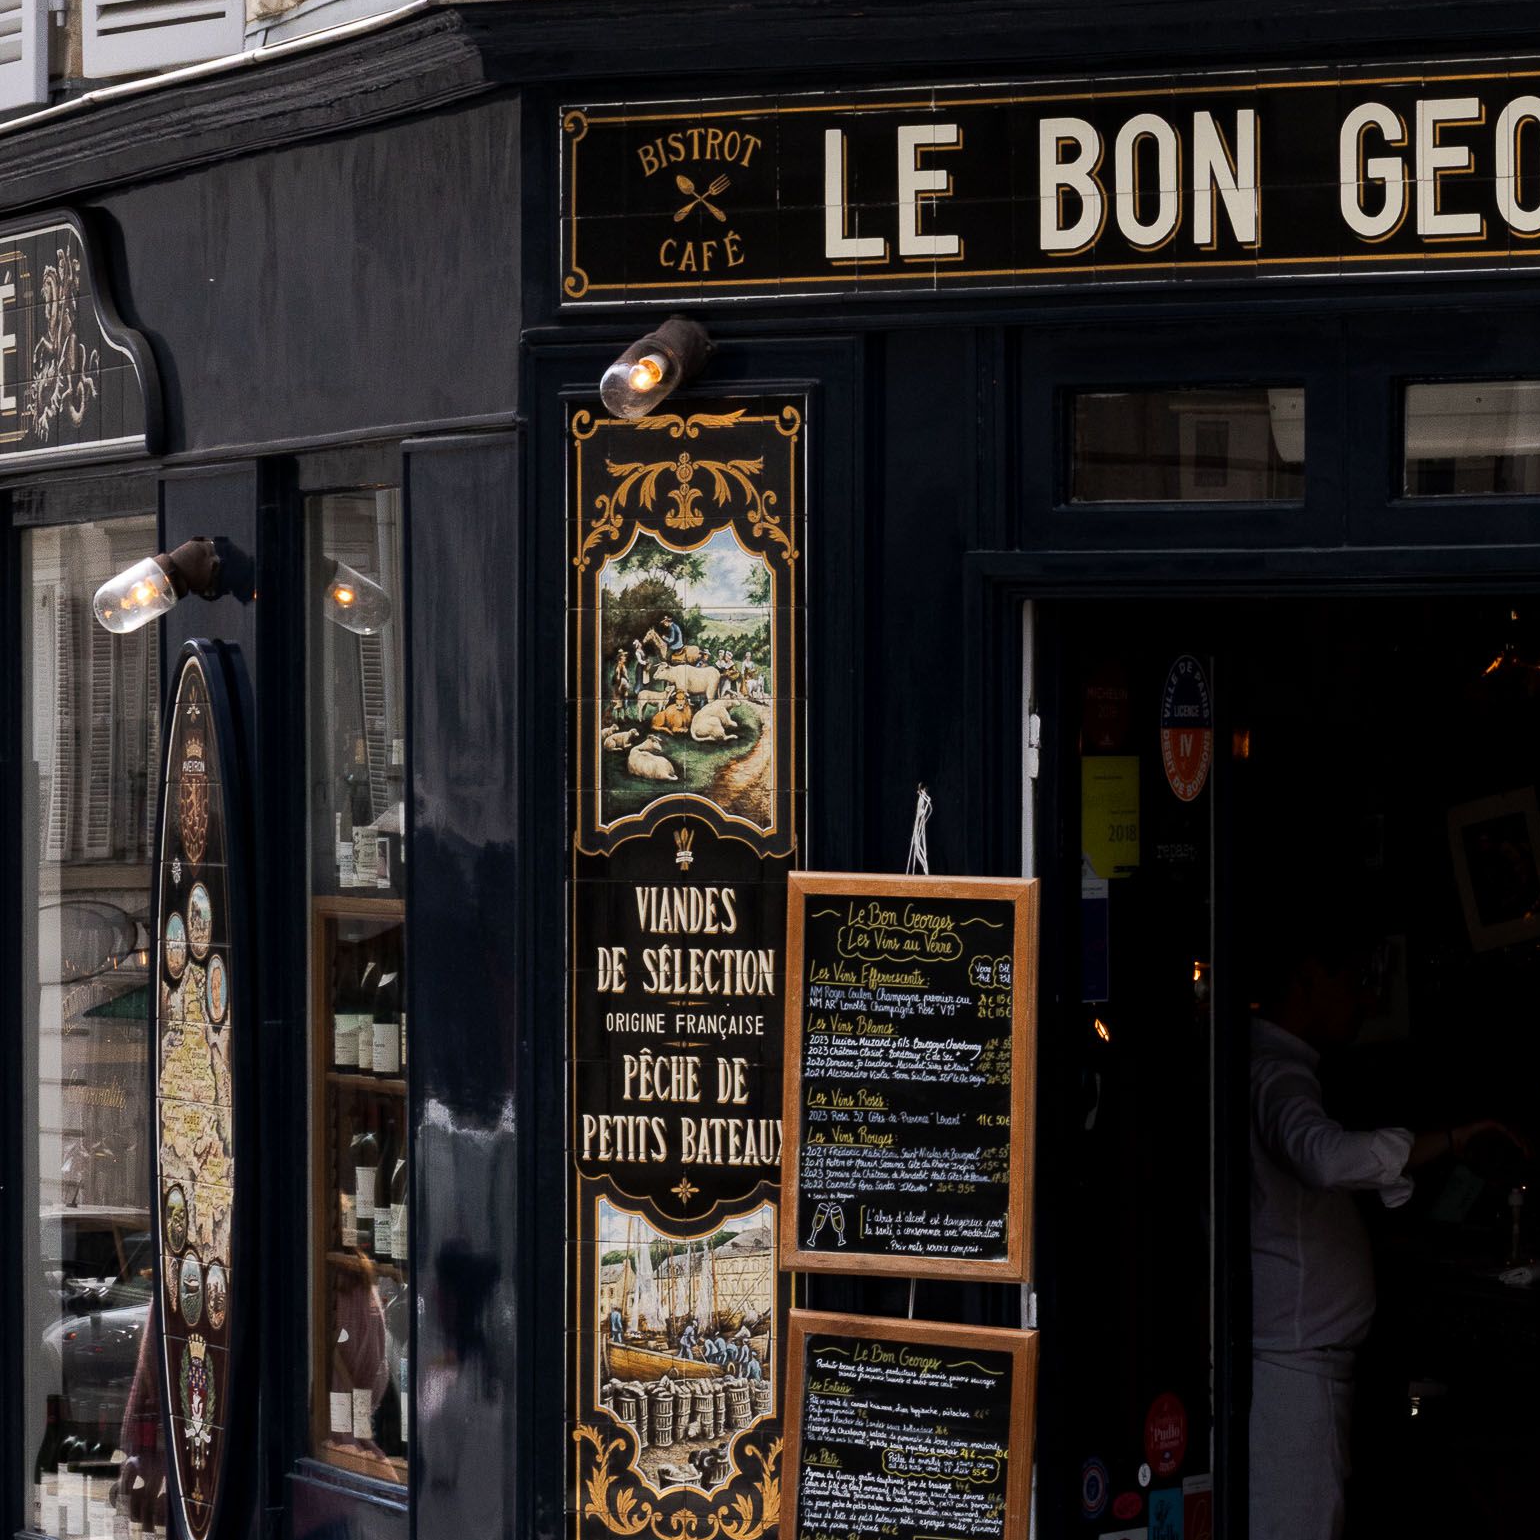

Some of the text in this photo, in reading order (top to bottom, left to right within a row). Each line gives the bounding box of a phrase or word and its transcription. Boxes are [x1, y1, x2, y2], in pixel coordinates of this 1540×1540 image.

[638, 128, 762, 178] BISTROT
[826, 124, 963, 263] LE
[1039, 110, 1262, 257] BON
[659, 230, 744, 272] CAFÉ
[1163, 661, 1210, 718] VILLE DE PARIS
[1179, 734, 1193, 758] IV
[1107, 824, 1137, 843] 2018
[635, 885, 737, 935] VIANDES
[848, 901, 956, 939] Le Bon Georges
[848, 928, 953, 953] Les Vins au Verre
[597, 944, 775, 996] DE SÉLECTION
[810, 959, 830, 982] Les
[833, 960, 857, 983] Vins
[876, 987, 920, 1007] Champagne
[606, 1012, 765, 1041] ORIGINE FRANÇAISE
[807, 1013, 826, 1033] Les
[830, 1014, 853, 1034] Vins
[623, 1047, 749, 1104] PÊCHE DE
[807, 1086, 827, 1106] Les
[831, 1087, 854, 1107] Vins
[582, 1114, 669, 1162] PETITS
[807, 1125, 826, 1144] Les
[831, 1126, 854, 1144] Vins
[853, 1342, 942, 1373] Le Bon Georges
